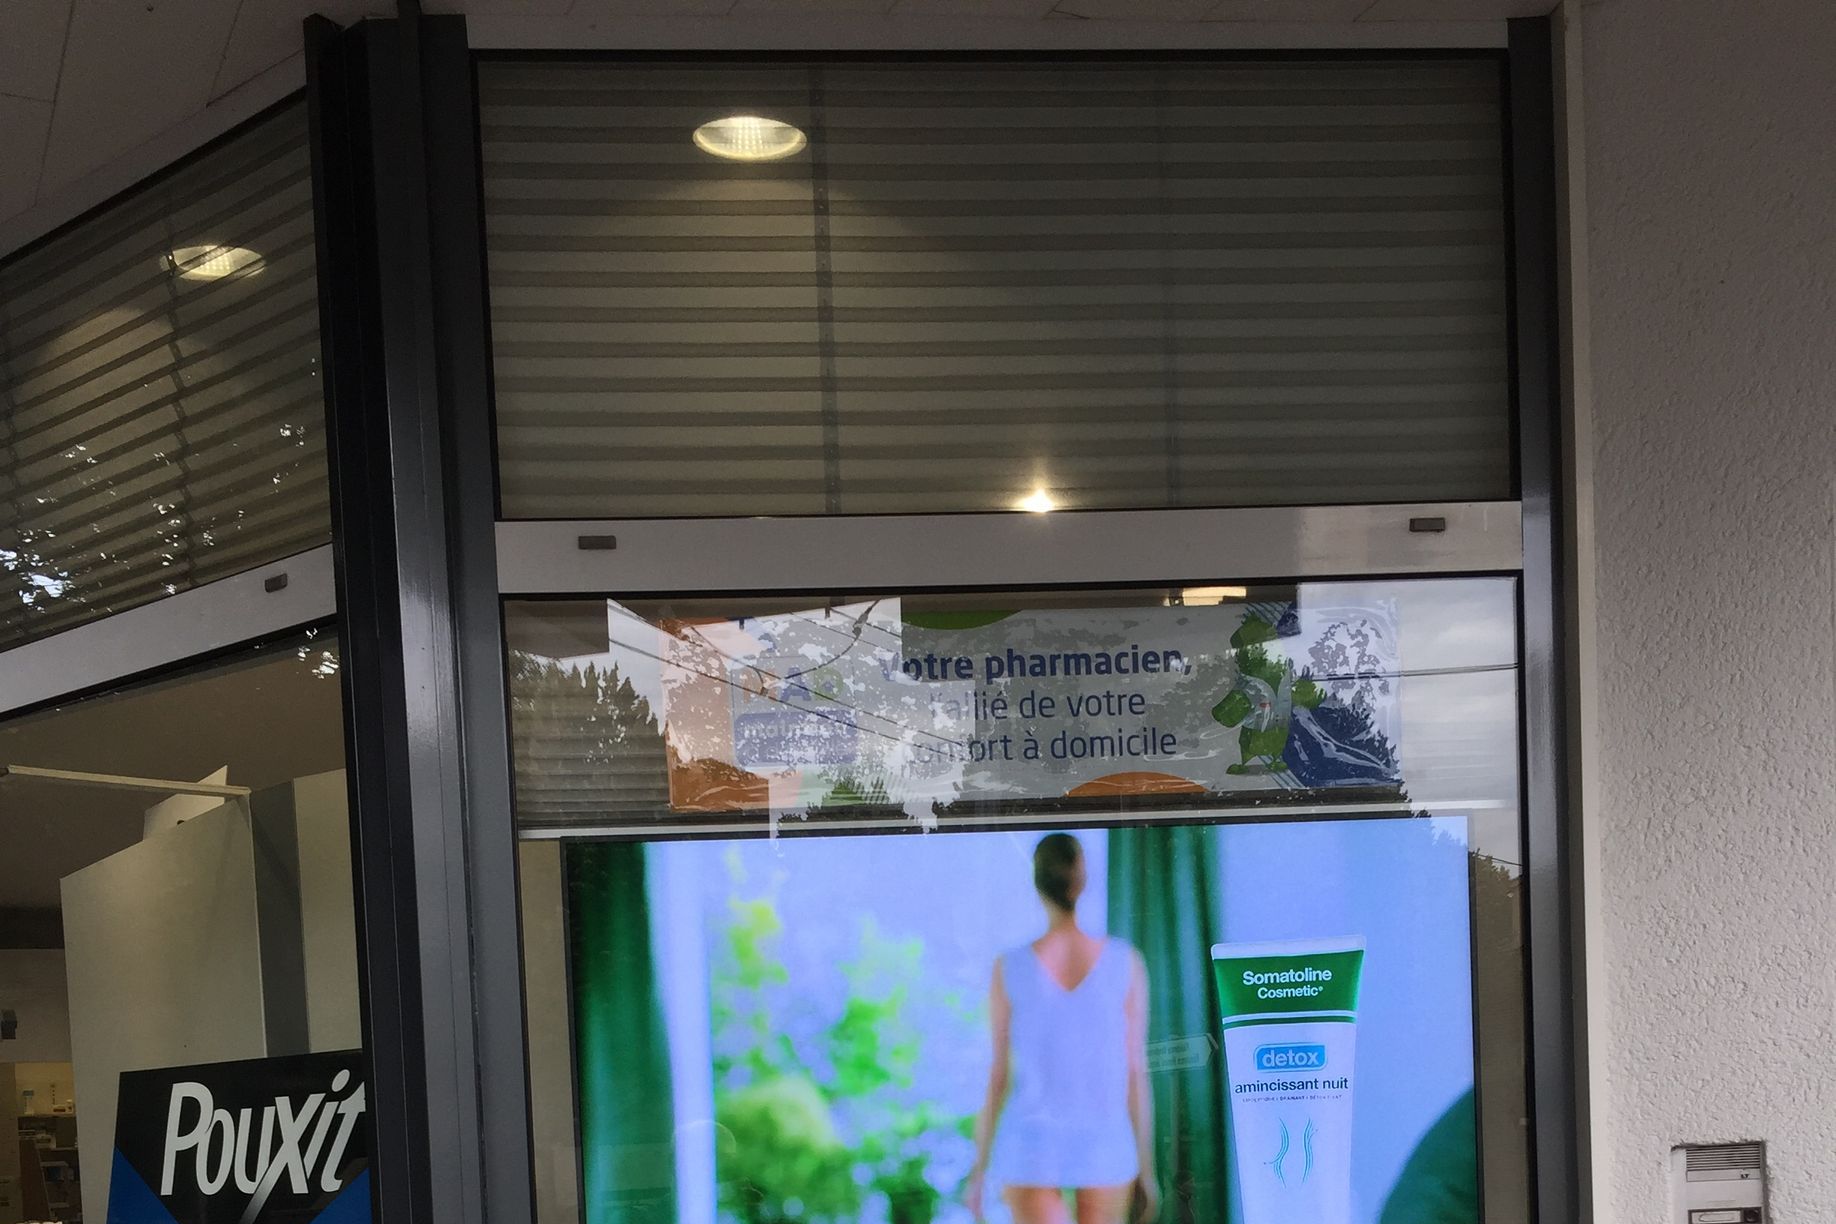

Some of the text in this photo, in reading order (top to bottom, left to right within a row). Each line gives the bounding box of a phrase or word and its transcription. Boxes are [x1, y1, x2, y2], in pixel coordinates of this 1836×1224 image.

[879, 644, 1193, 684] Votre pharmacien,
[1019, 691, 1055, 719] de
[1067, 690, 1146, 717] votre
[1023, 730, 1040, 760] à
[1050, 727, 1177, 759] domicile
[1242, 967, 1332, 986] Somatoline
[1262, 1048, 1319, 1068] detox
[1235, 1077, 1349, 1094] amincissant nuit
